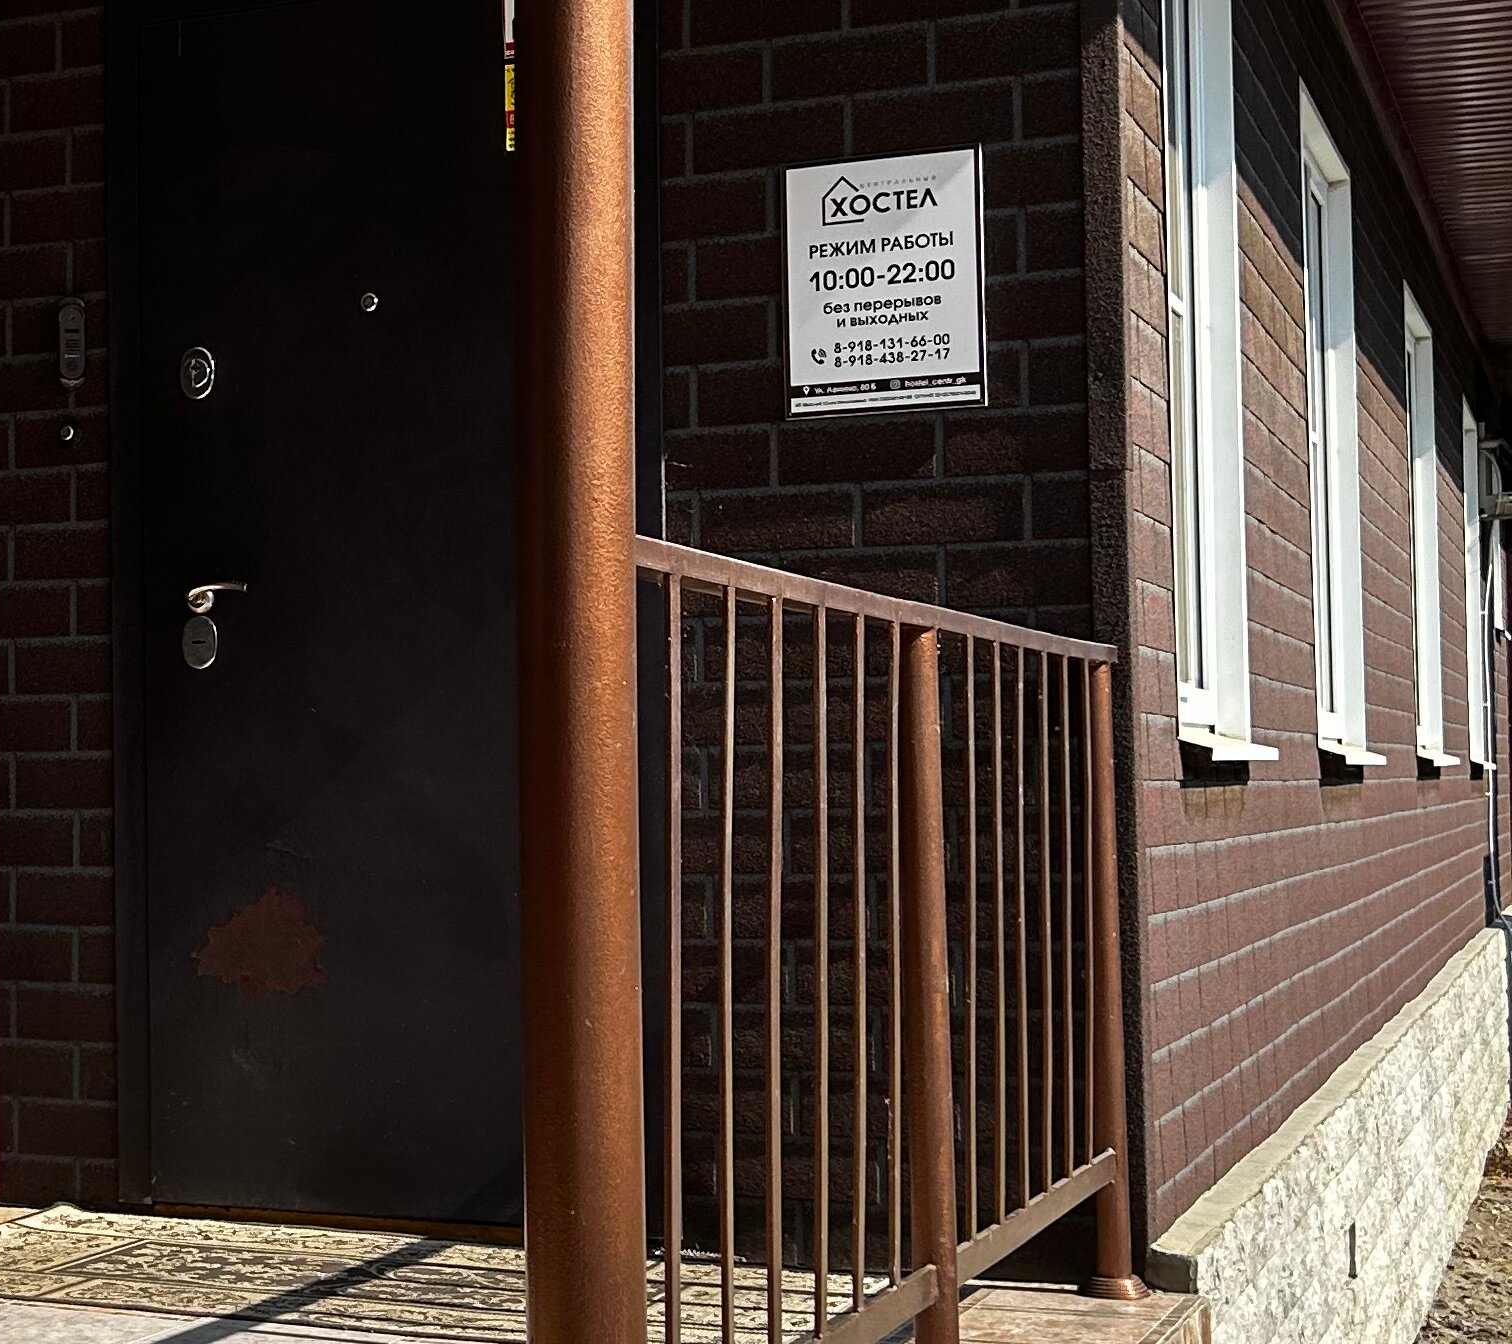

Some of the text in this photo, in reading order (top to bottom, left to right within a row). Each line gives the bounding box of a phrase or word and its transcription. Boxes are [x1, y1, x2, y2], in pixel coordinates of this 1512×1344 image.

[830, 187, 939, 218] ХОСТЕЛ
[809, 230, 954, 259] РЕЖИМ РАБОТЫ
[809, 258, 956, 292] 10:00-22:00
[823, 295, 943, 315] без перерывов
[849, 310, 930, 327] выходных
[833, 333, 951, 354] 8-918-131-66-00
[833, 347, 951, 368] 8-918-438-27-17
